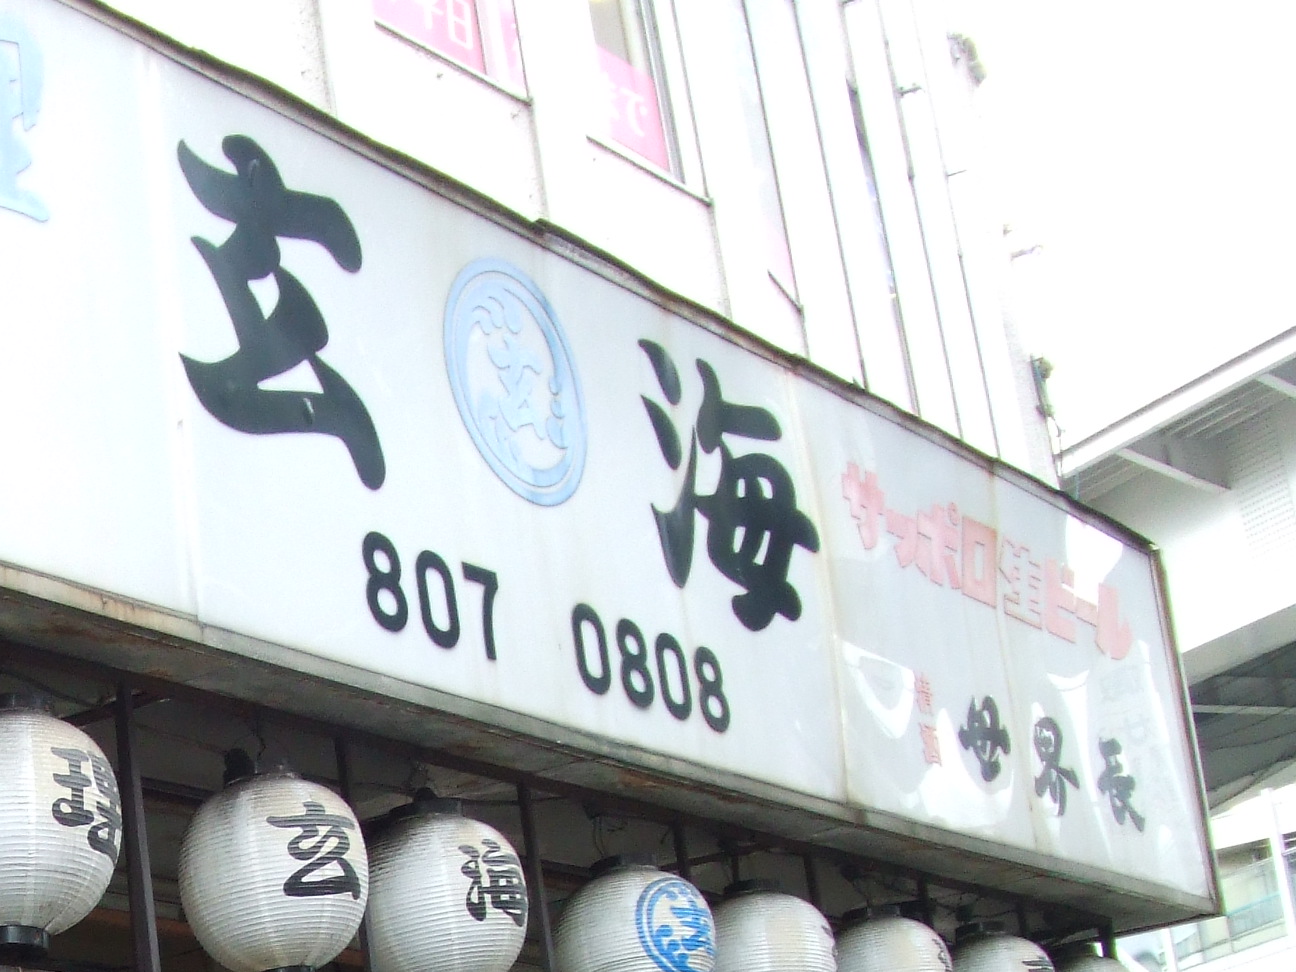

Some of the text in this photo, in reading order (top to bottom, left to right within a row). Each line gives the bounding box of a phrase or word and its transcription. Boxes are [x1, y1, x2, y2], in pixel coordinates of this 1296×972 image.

[178, 134, 820, 632] 玄 海
[362, 531, 731, 734] 807 0808
[266, 801, 362, 901] 玄
[458, 838, 529, 927] 海
